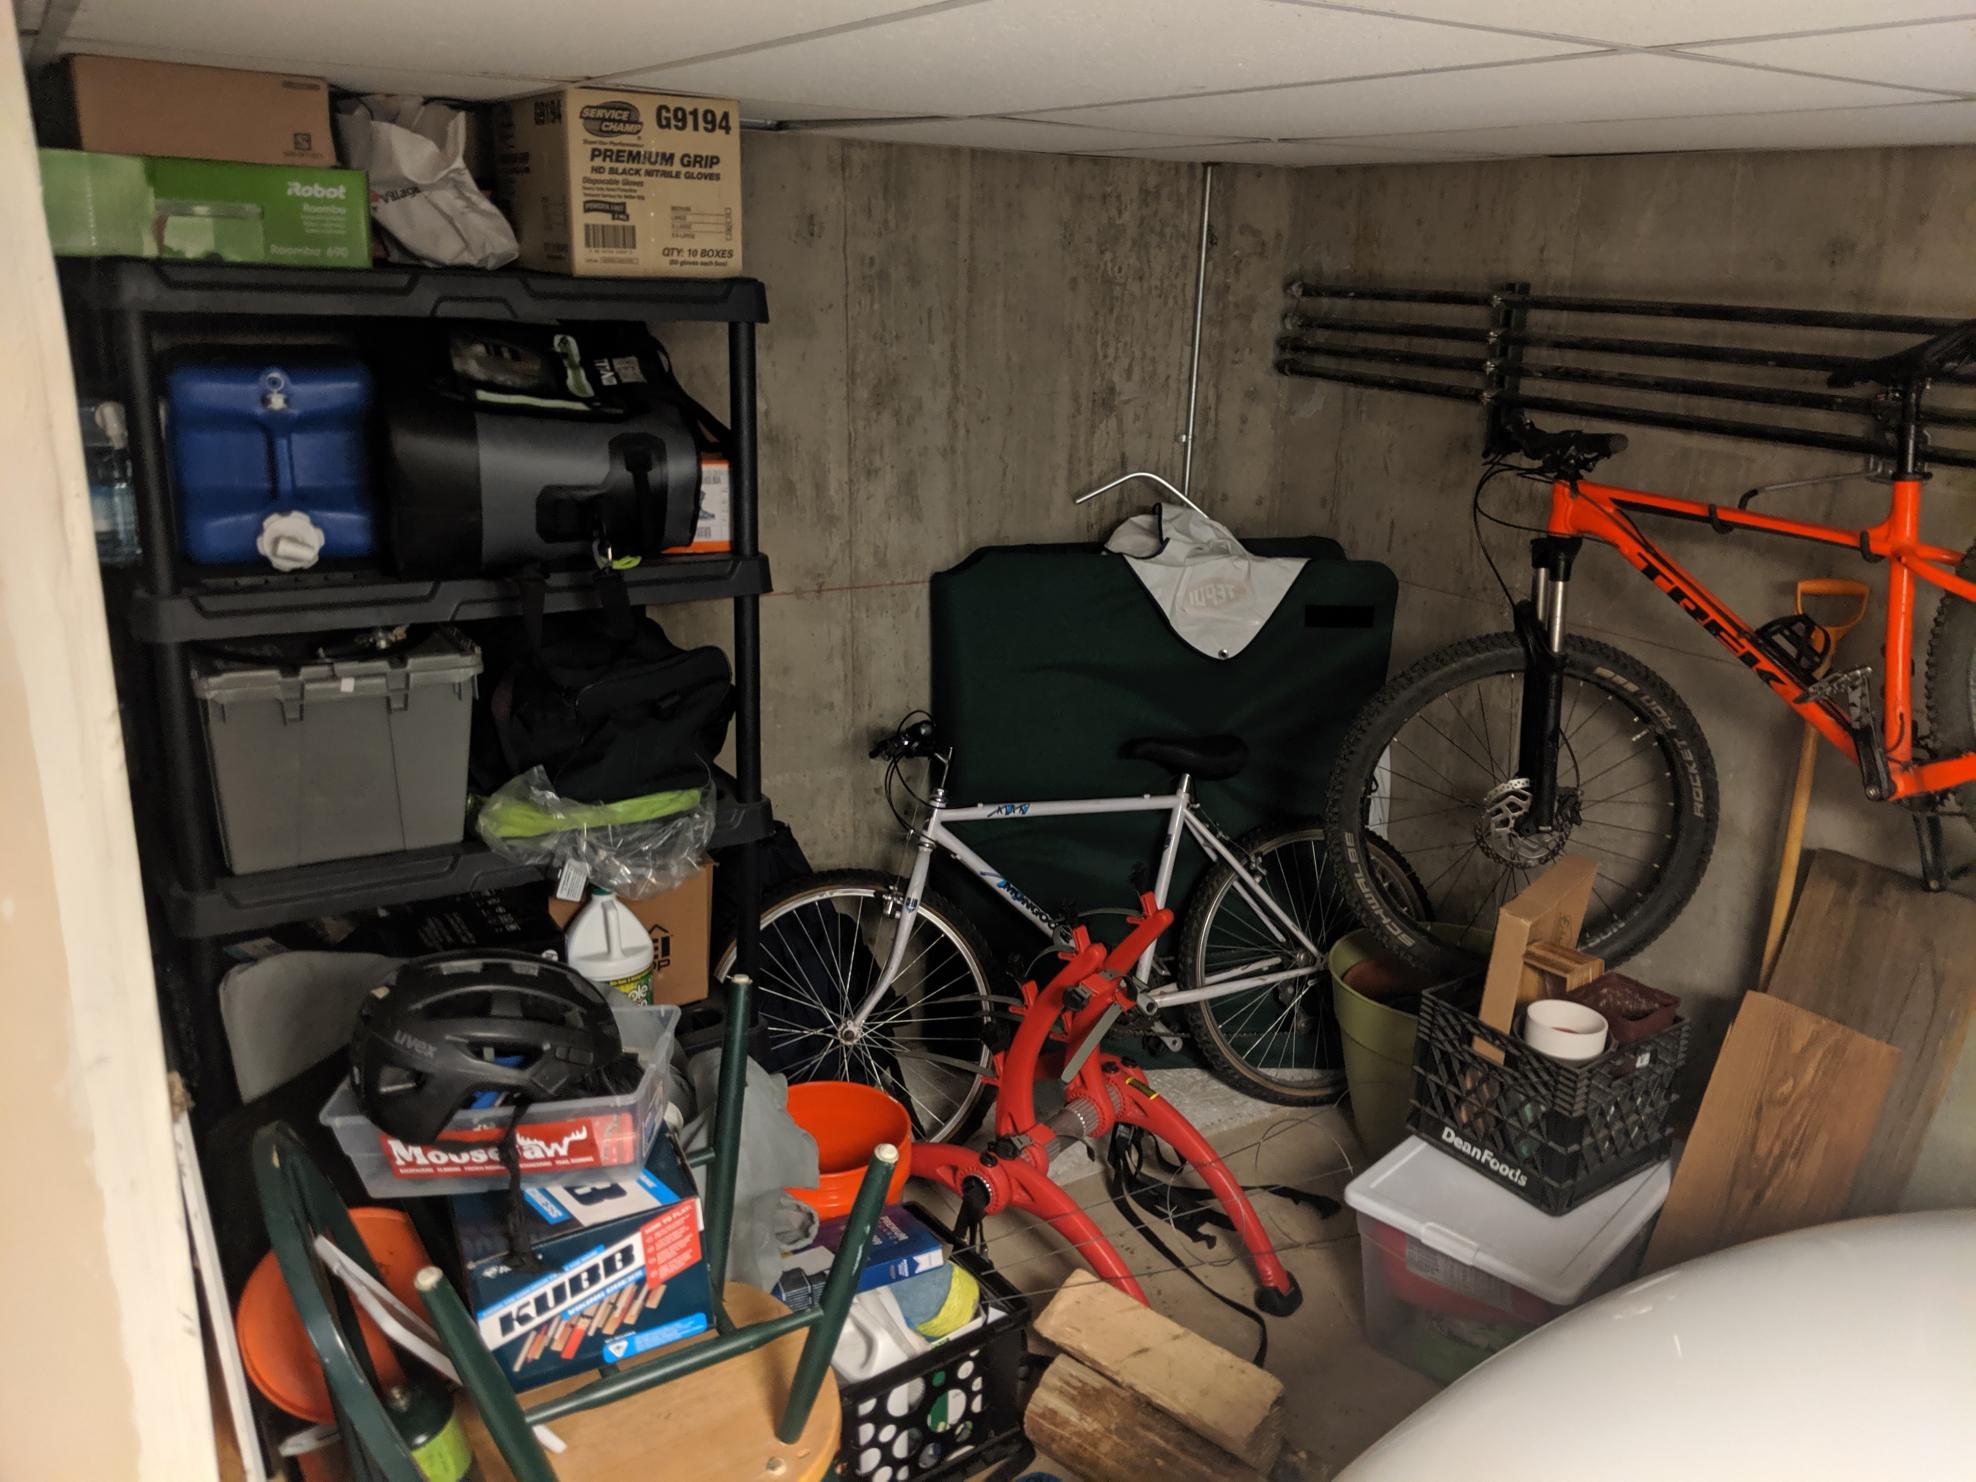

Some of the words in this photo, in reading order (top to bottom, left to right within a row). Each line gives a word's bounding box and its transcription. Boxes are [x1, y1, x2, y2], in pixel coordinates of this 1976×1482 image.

[581, 107, 630, 120] SERVICE
[655, 104, 732, 135] G9194
[601, 122, 642, 134] CHAMP
[590, 147, 675, 166] PREMIUM
[680, 153, 720, 168] GRIP
[591, 165, 605, 174] HD
[608, 167, 641, 177] BLACK
[644, 169, 681, 179] NITRILE
[684, 171, 720, 181] GLOVES
[662, 247, 684, 258] QTY:
[688, 248, 699, 258] 10
[700, 248, 734, 259] BOXES
[1637, 552, 1787, 692] TREK
[1344, 831, 1416, 948] SCHWALBE
[499, 1243, 636, 1339] KUBB
